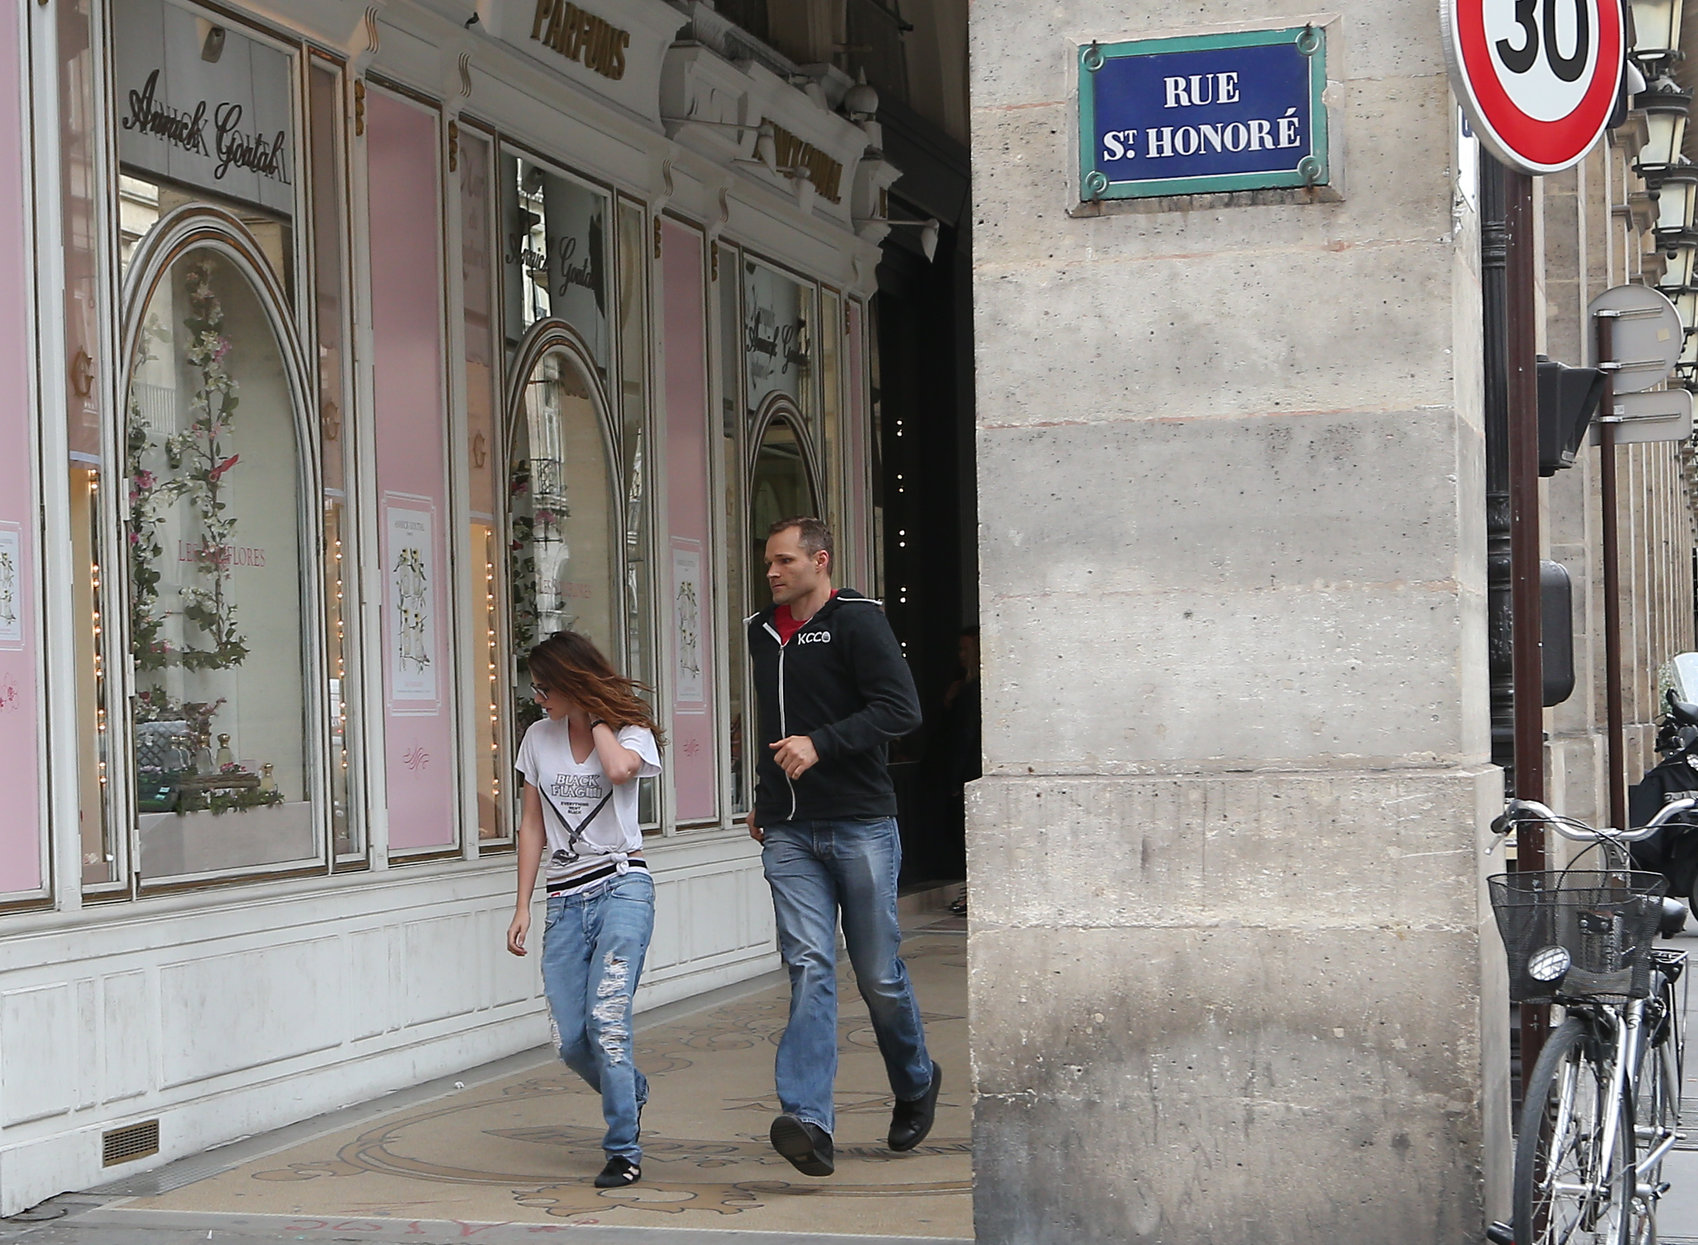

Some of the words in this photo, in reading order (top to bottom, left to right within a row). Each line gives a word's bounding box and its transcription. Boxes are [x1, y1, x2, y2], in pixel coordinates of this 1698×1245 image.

[1495, 0, 1589, 82] 30
[1164, 72, 1240, 108] RUE
[214, 102, 285, 180] Goutal
[1146, 107, 1300, 158] HONORÉ
[797, 631, 831, 645] KCCO
[556, 773, 601, 788] BLACK
